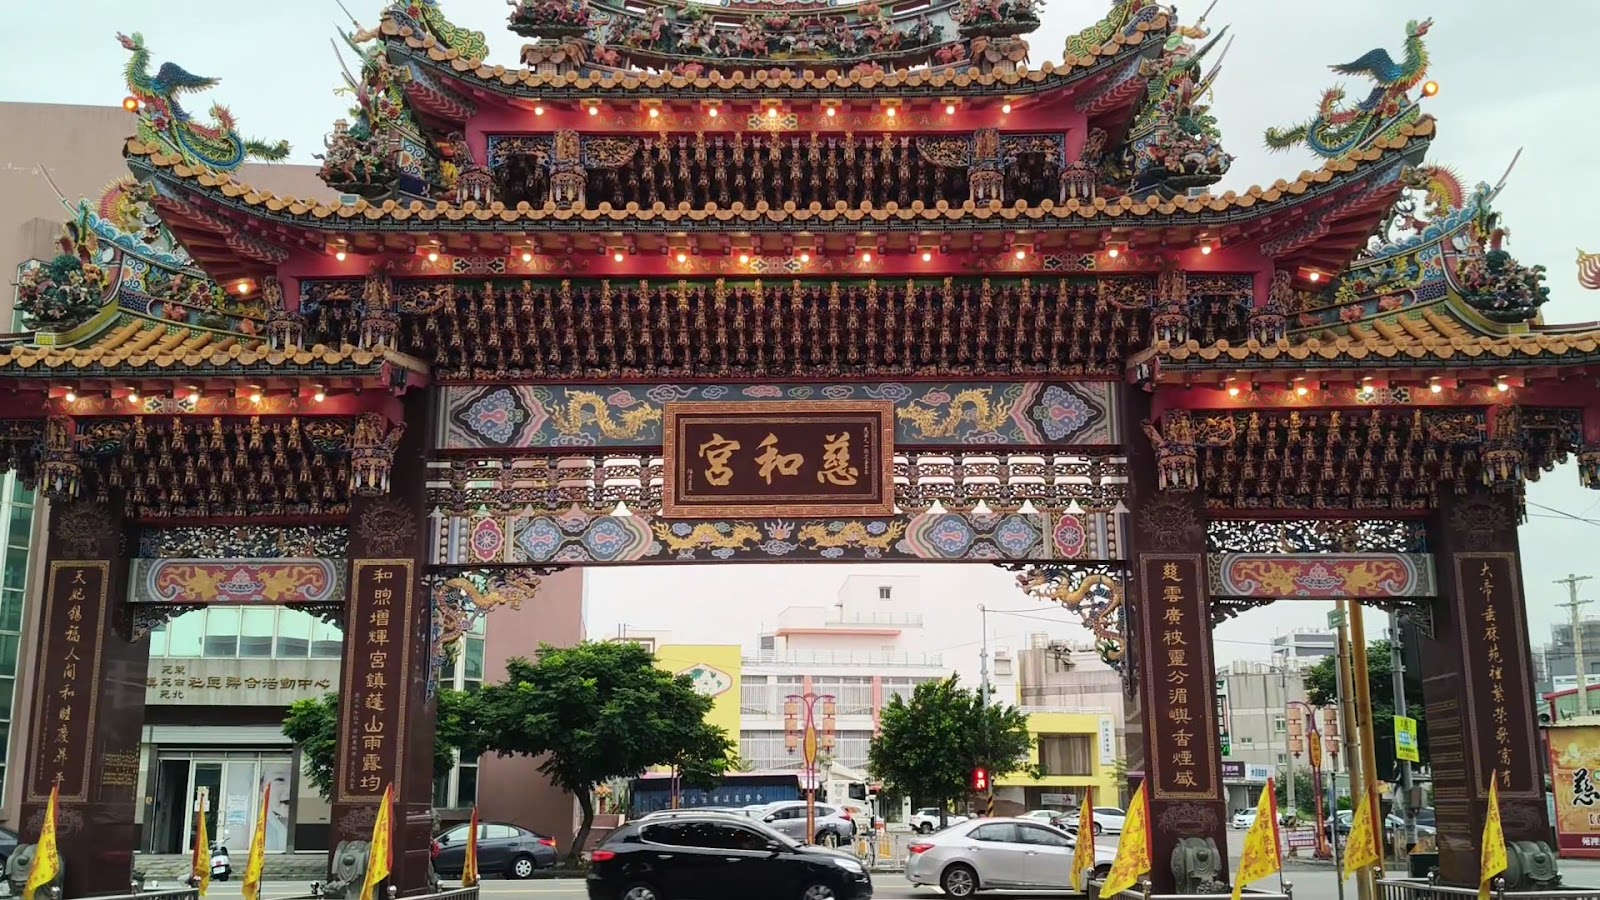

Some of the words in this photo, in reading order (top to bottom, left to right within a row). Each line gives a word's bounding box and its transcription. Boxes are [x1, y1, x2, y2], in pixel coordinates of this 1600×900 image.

[699, 431, 859, 487] 慈和宮
[188, 676, 331, 691] 社區聯合活動中心
